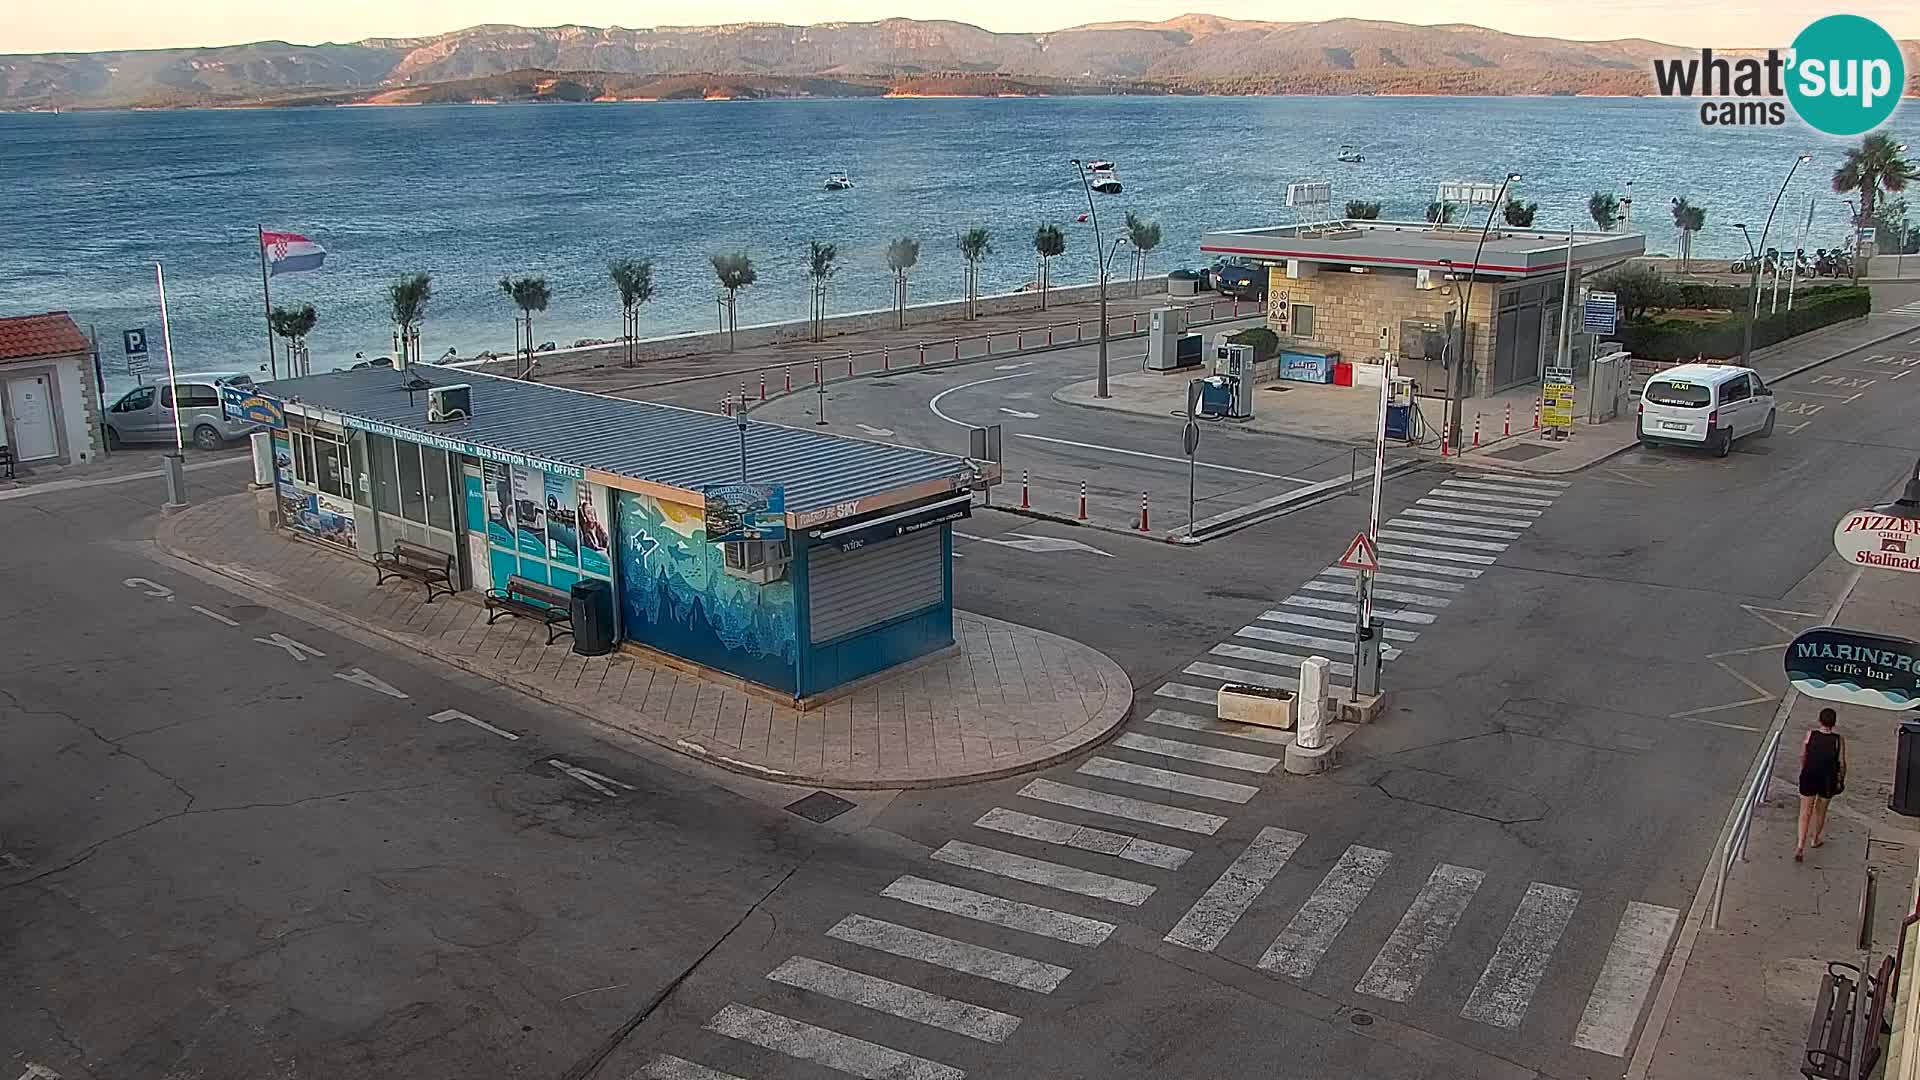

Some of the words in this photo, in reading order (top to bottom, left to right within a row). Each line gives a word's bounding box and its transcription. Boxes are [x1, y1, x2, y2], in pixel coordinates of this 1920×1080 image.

[128, 332, 141, 350] P
[346, 418, 371, 431] PRODAJA
[395, 428, 434, 446] AUTOBUSNA
[435, 436, 467, 453] POSTAJA
[476, 446, 491, 457] BUS
[493, 451, 524, 466] STATION
[526, 458, 552, 473] TICKET
[554, 464, 581, 478] OFFICE
[1878, 531, 1913, 541] GRILL
[1825, 663, 1862, 675] caffe
[1866, 667, 1894, 680] bar
